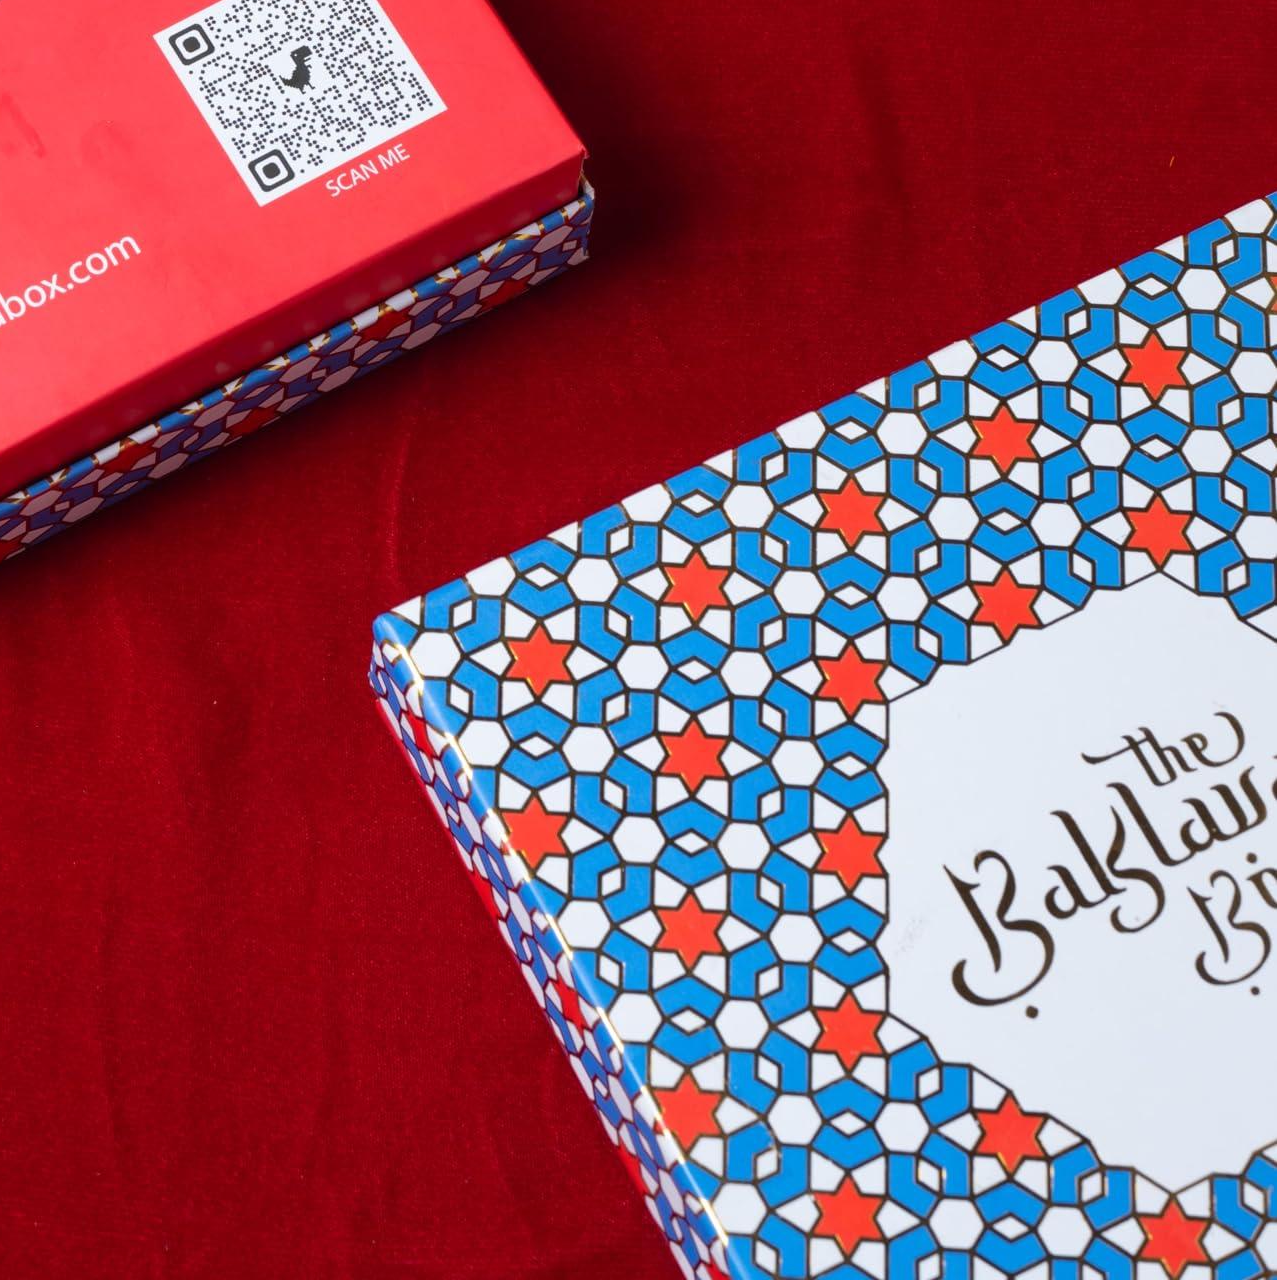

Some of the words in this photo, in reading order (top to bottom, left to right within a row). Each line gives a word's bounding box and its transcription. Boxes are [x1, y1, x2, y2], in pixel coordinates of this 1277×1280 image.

[325, 160, 379, 197] SCAN
[377, 143, 411, 170] ME
[1081, 711, 1245, 786] the
[942, 754, 1277, 1019] Baklav
